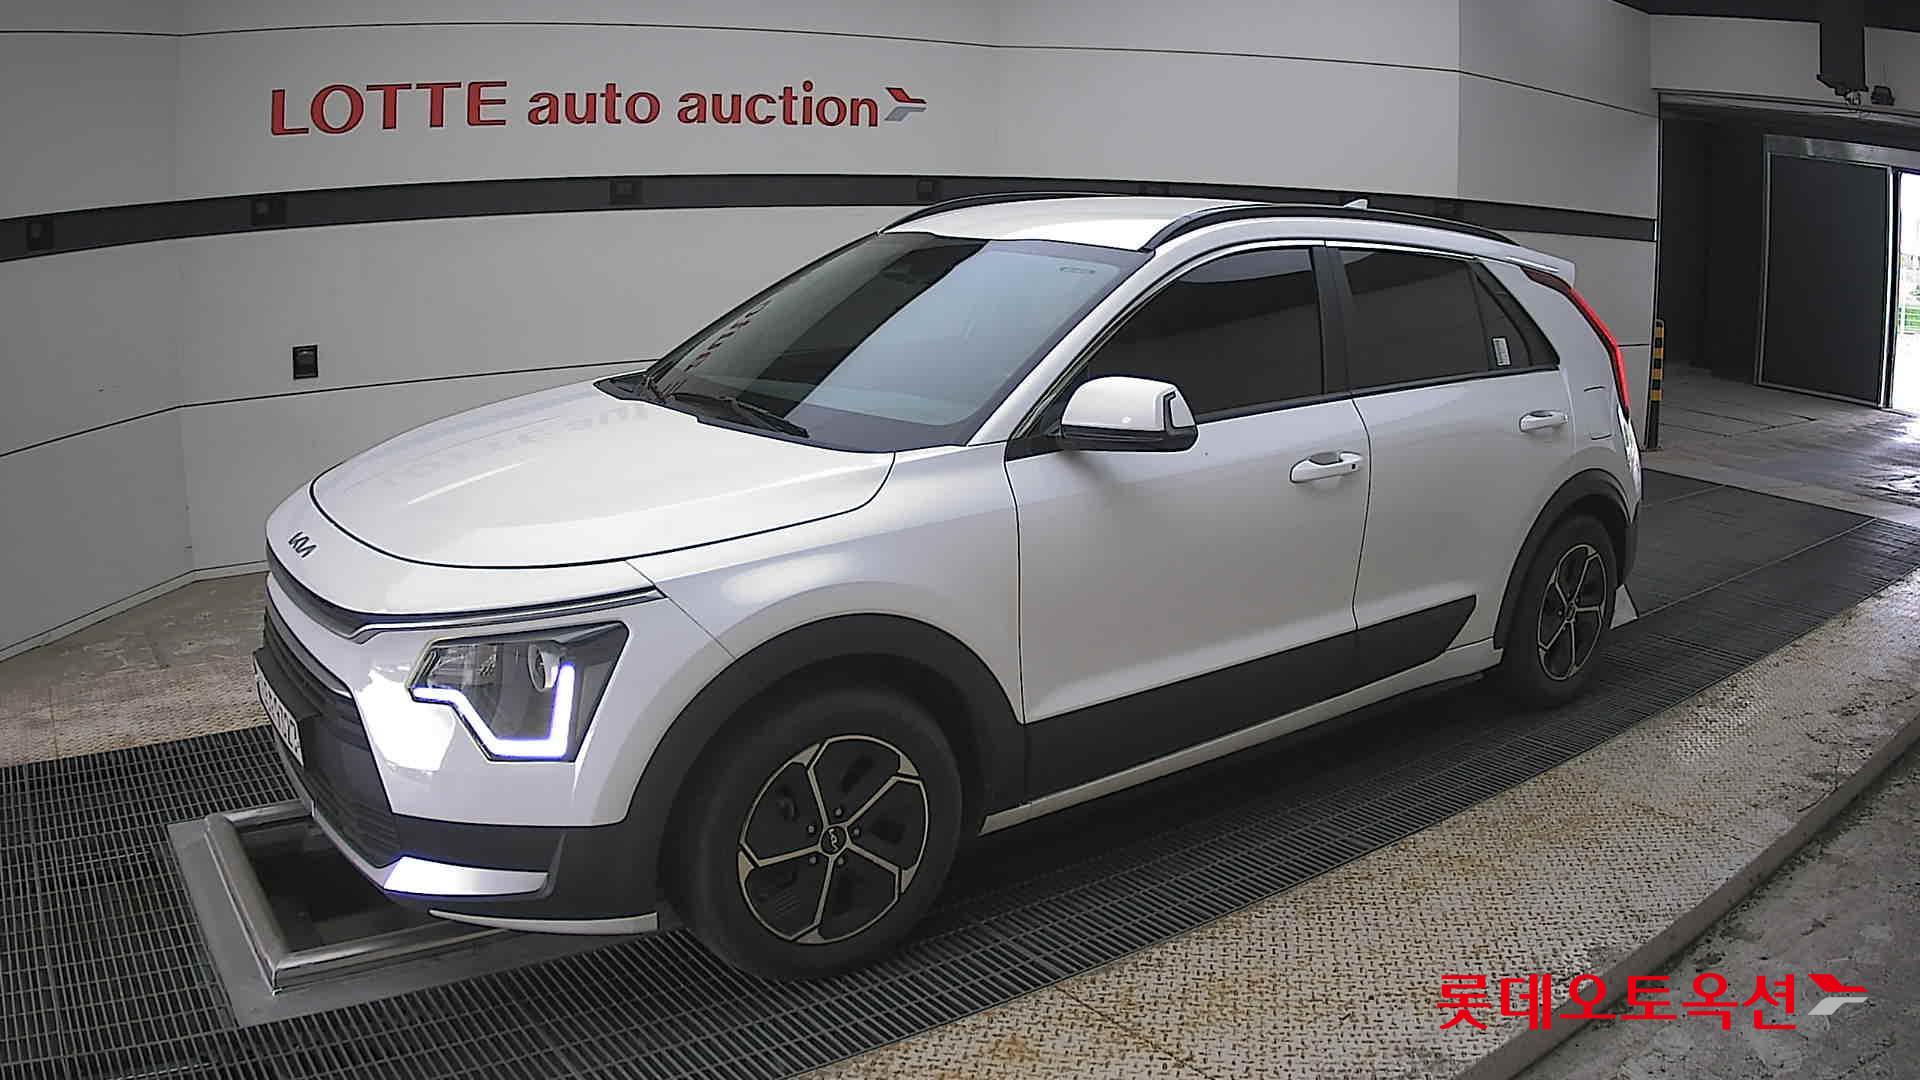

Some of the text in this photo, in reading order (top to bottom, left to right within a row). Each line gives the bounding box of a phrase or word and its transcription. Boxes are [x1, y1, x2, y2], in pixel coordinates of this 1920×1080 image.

[270, 81, 878, 135] LOTTE auto auction
